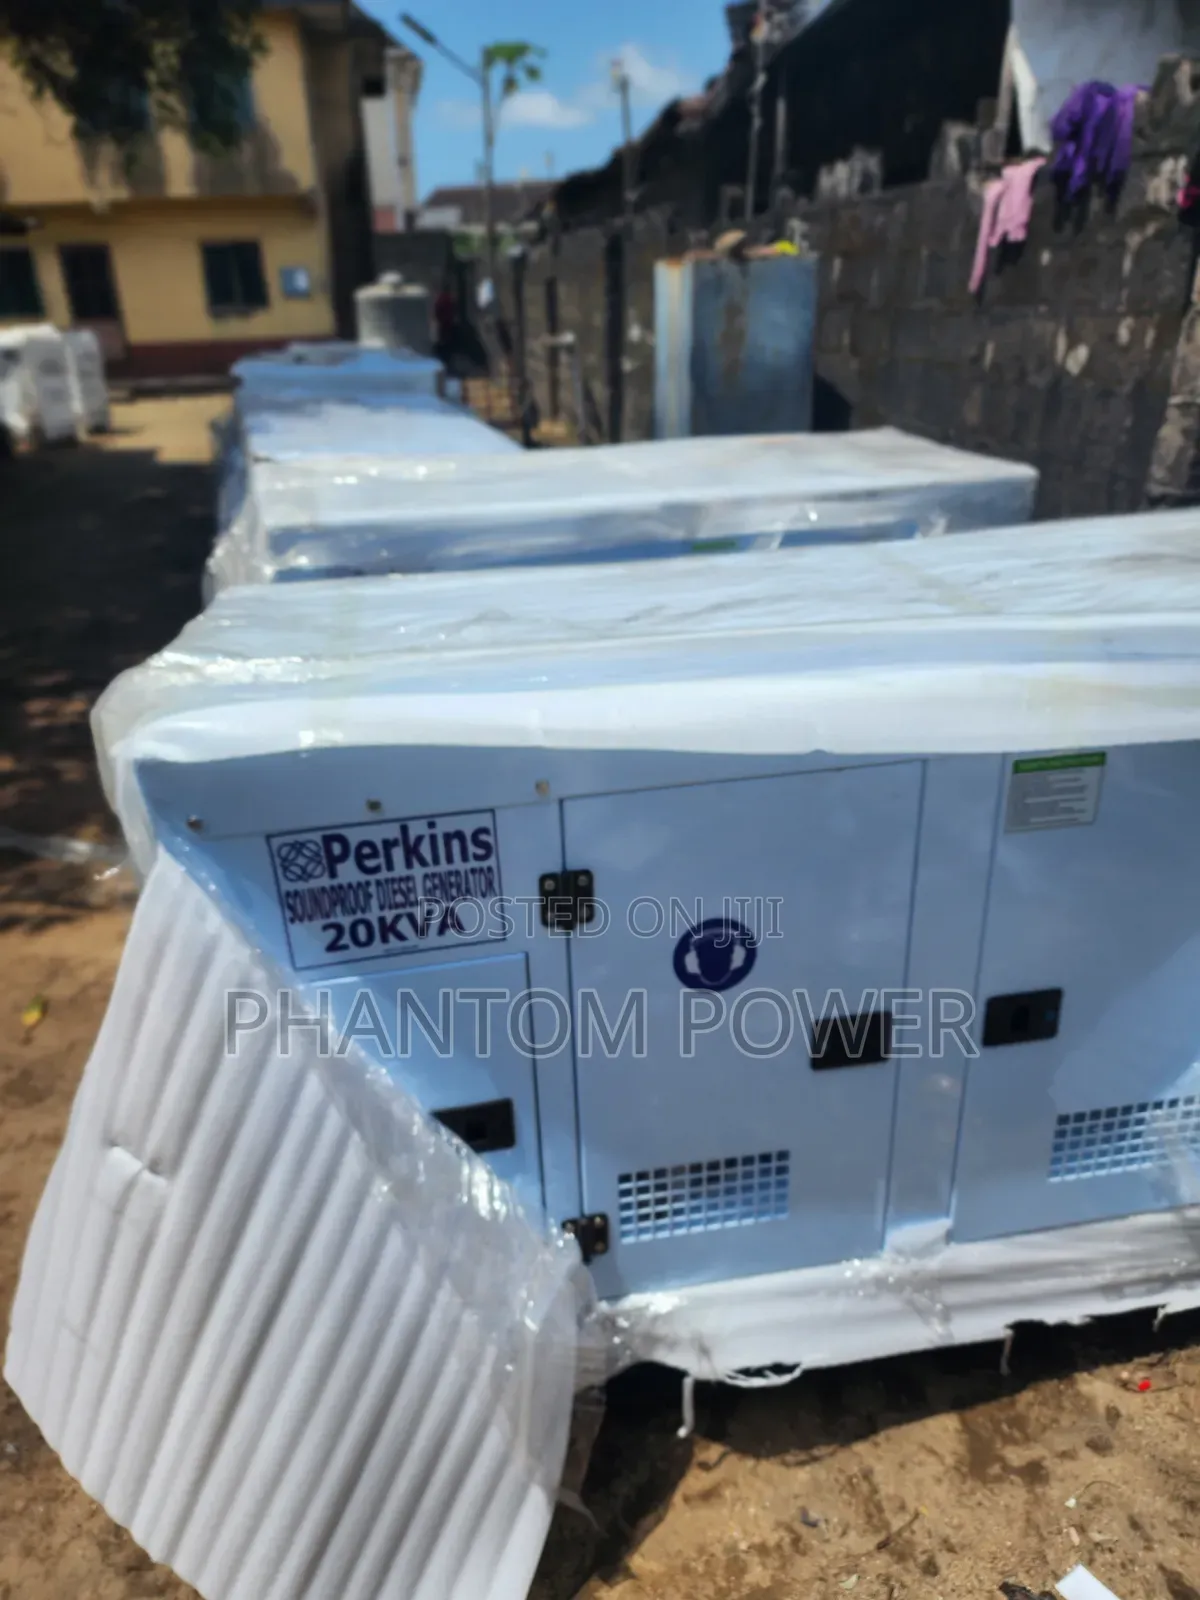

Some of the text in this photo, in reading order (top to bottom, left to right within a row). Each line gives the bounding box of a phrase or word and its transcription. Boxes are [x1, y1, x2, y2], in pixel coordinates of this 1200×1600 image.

[320, 820, 495, 880] Perkins
[284, 865, 498, 924] SOUNDPROOF DIESEL GENERATOR
[321, 906, 467, 953] 20KVA
